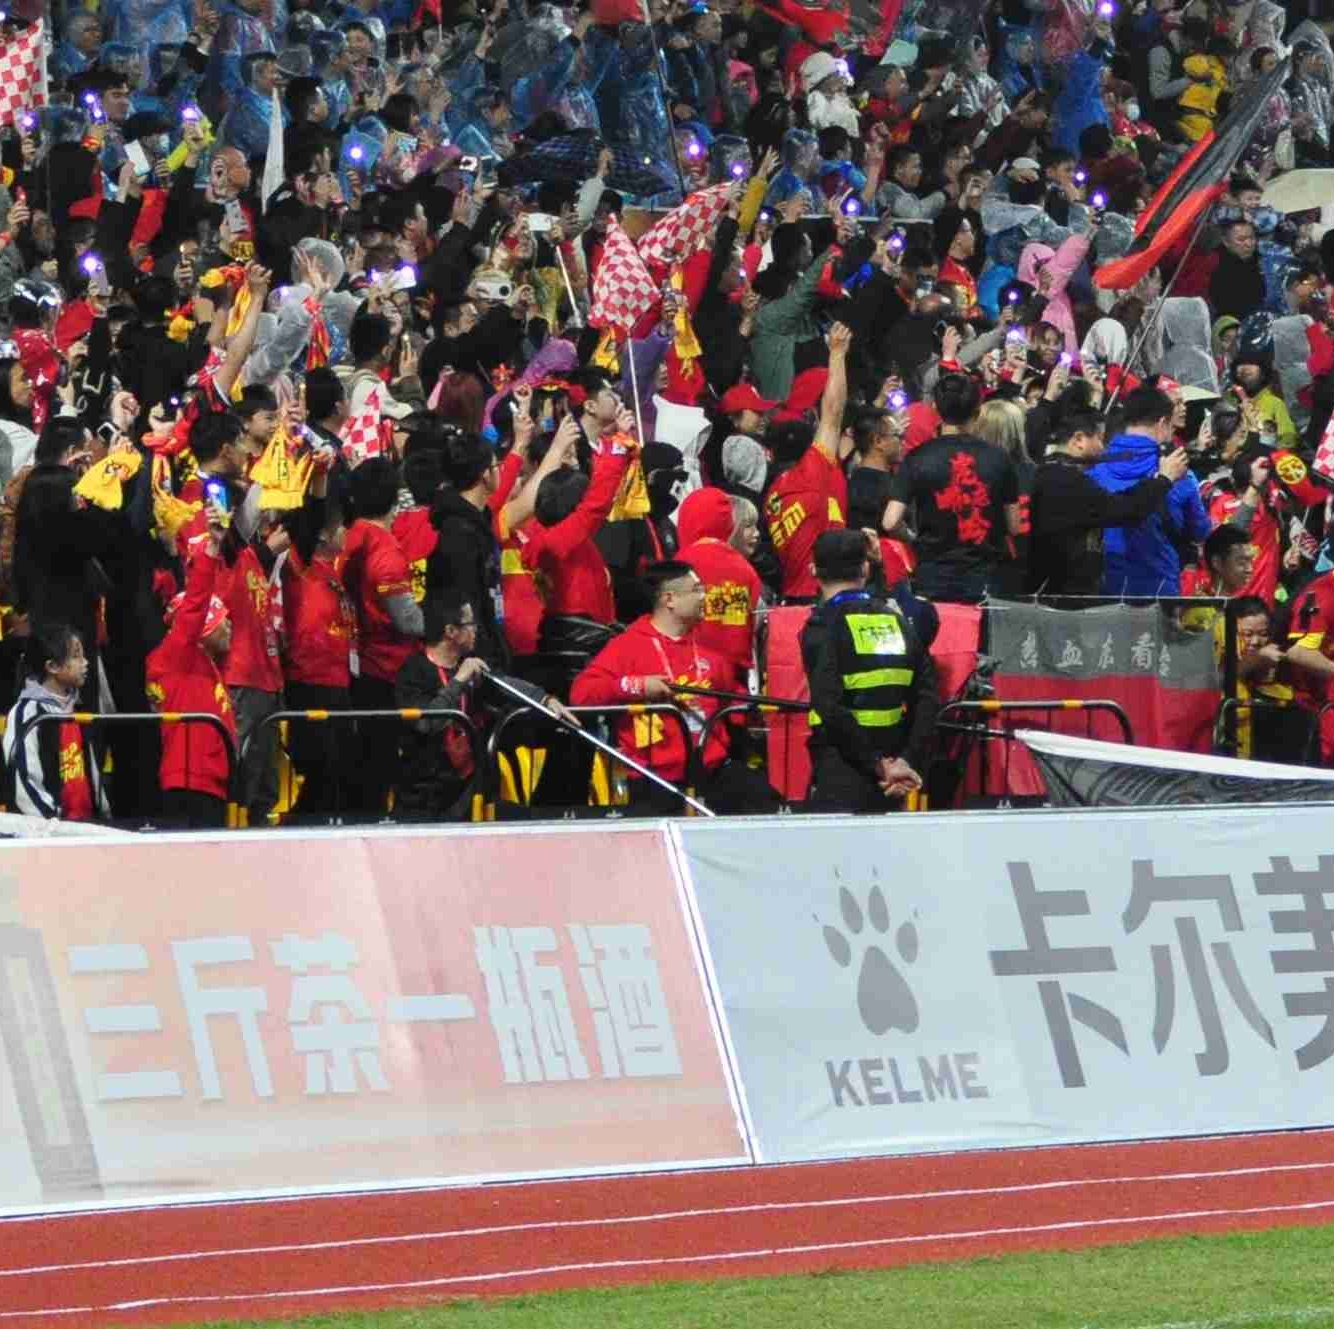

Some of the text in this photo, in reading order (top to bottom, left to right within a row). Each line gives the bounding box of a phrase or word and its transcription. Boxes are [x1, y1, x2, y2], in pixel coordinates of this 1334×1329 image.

[68, 923, 683, 1103] 三斤茶一瓶酒
[824, 1051, 989, 1107] KELME
